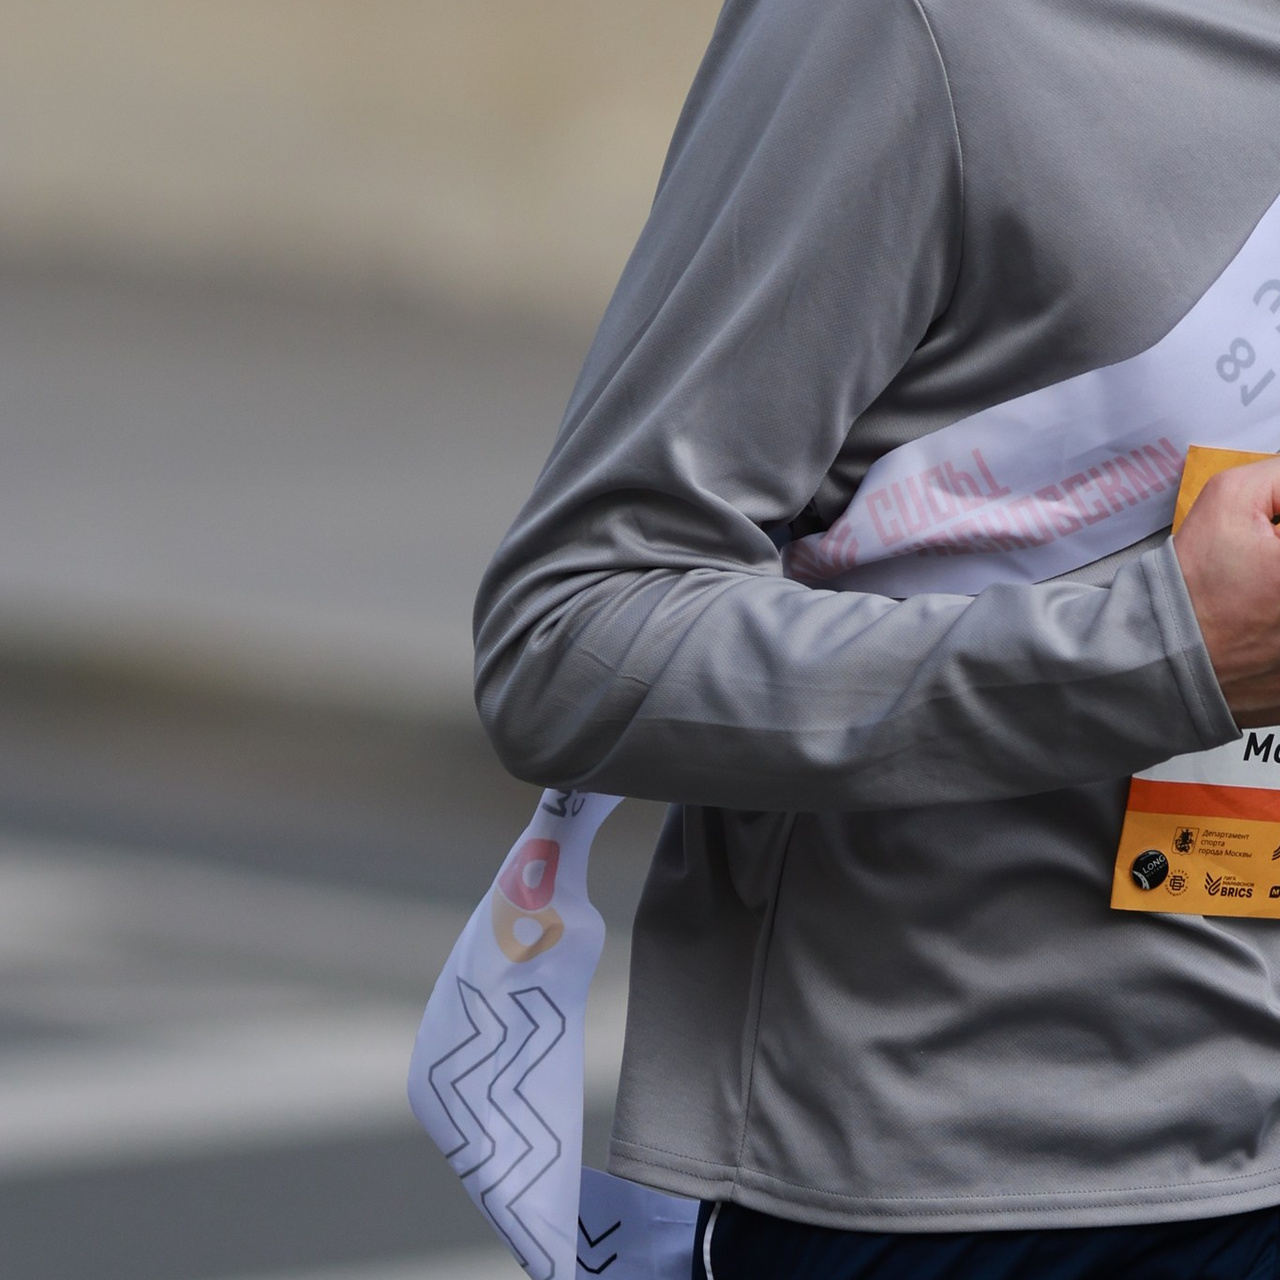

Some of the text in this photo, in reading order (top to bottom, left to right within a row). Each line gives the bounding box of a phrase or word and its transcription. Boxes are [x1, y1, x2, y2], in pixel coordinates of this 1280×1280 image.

[1201, 829, 1250, 839] Департамент
[1200, 839, 1226, 848] спорта
[1198, 848, 1253, 858] города Москвы
[1142, 854, 1167, 874] LONG
[1220, 886, 1253, 899] BRICS
